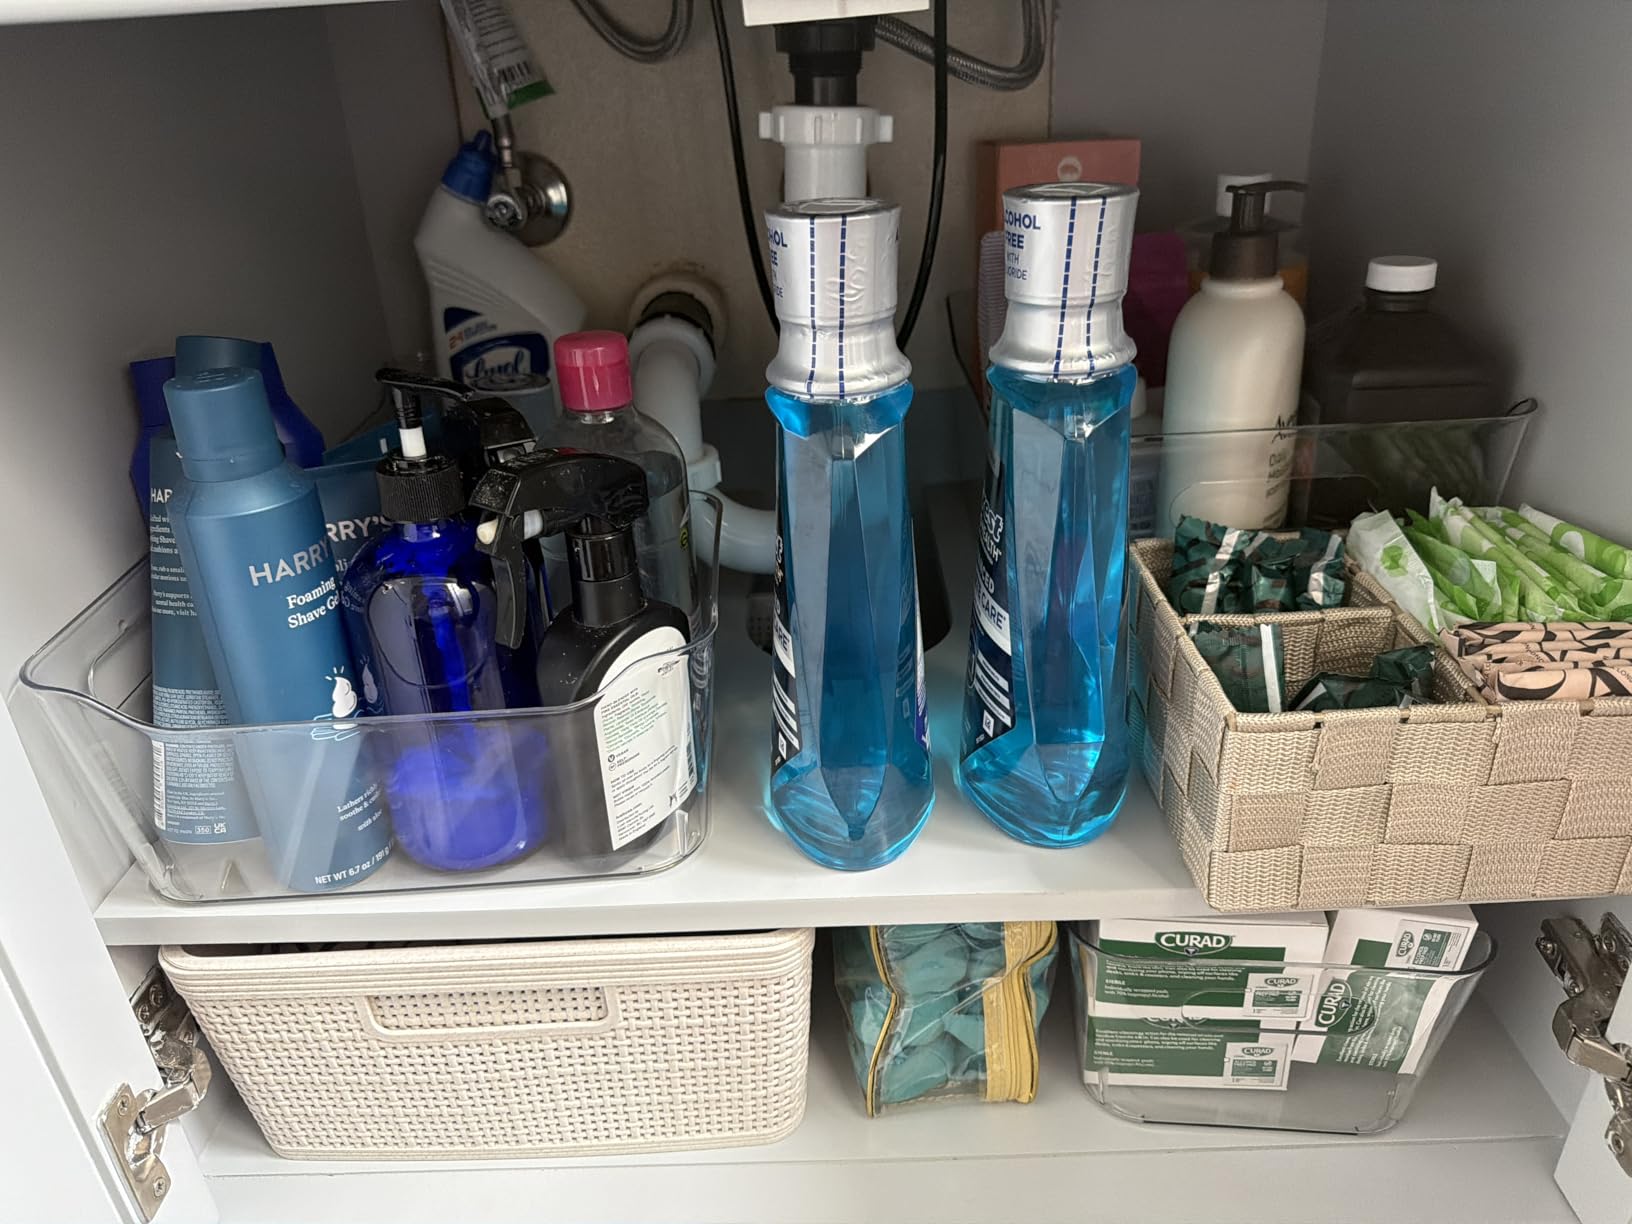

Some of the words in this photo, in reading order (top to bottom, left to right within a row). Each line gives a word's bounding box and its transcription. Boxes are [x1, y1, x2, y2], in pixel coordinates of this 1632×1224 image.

[286, 577, 336, 610] Foaming
[288, 604, 327, 629] Shave
[337, 795, 364, 813] Lathers
[314, 874, 332, 885] NET
[333, 870, 347, 881] WT
[348, 864, 360, 876] 6.7
[361, 860, 371, 871] oz
[1160, 934, 1226, 948] CURAD
[1397, 933, 1412, 956] CURAD
[1318, 983, 1346, 1025] CURAD
[1243, 1047, 1272, 1055] CURAD
